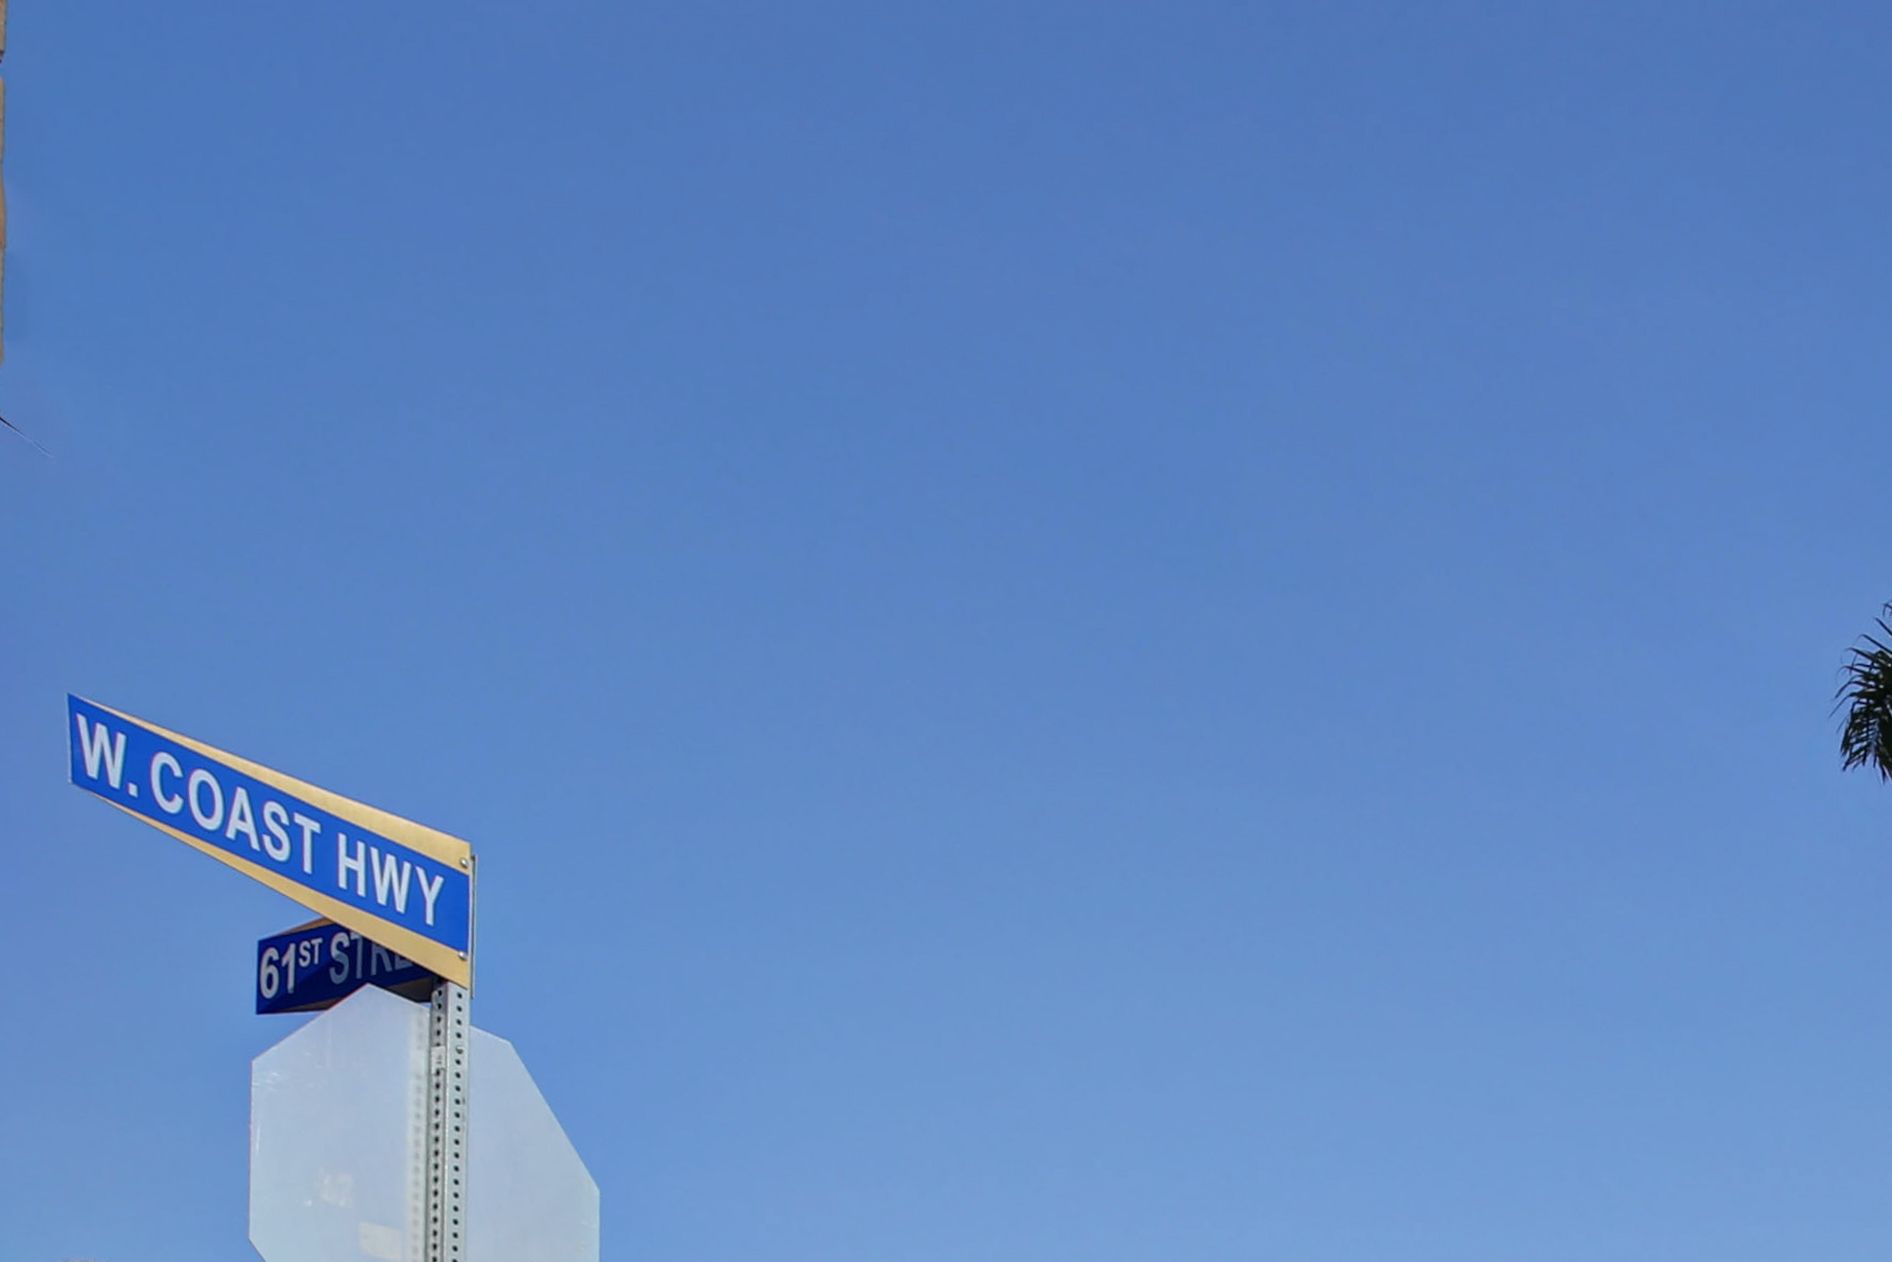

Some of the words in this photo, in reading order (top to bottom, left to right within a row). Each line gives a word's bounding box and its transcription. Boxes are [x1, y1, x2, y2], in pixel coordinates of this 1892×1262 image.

[76, 713, 138, 797] W.
[151, 751, 321, 874] COAST
[337, 832, 444, 926] HWY
[259, 937, 324, 999] 61ST
[329, 931, 412, 984] STR
